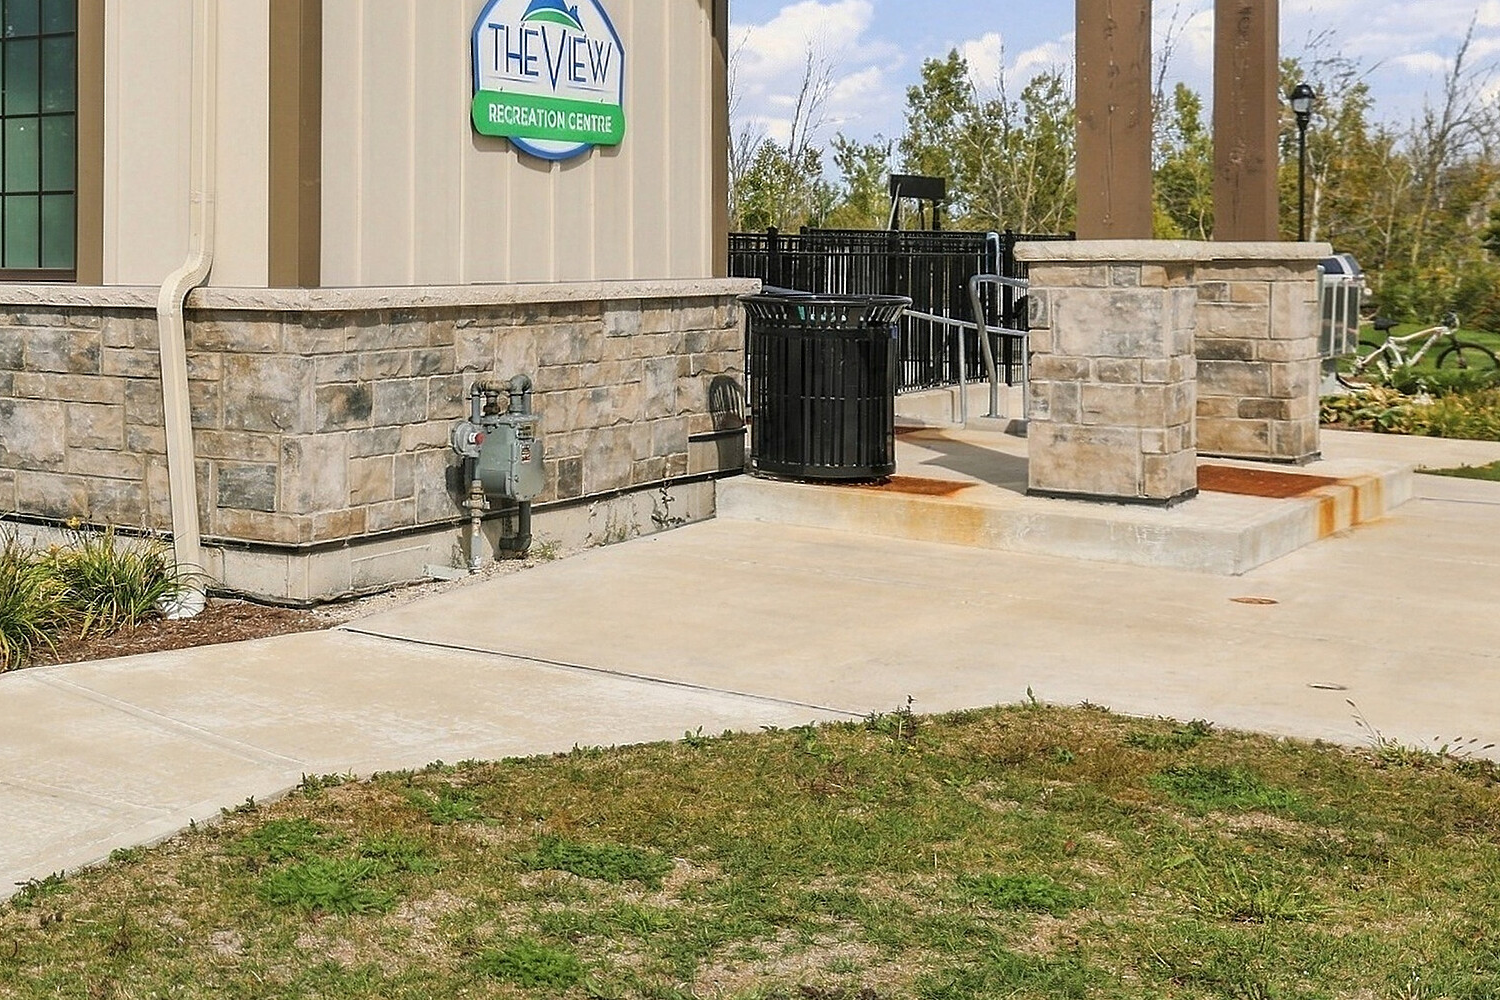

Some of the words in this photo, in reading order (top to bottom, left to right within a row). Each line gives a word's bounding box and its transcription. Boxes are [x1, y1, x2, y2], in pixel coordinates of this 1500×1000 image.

[488, 22, 539, 76] THE
[541, 26, 612, 91] VIEW
[489, 104, 565, 129] RECREATION
[569, 112, 612, 133] CENTRE
